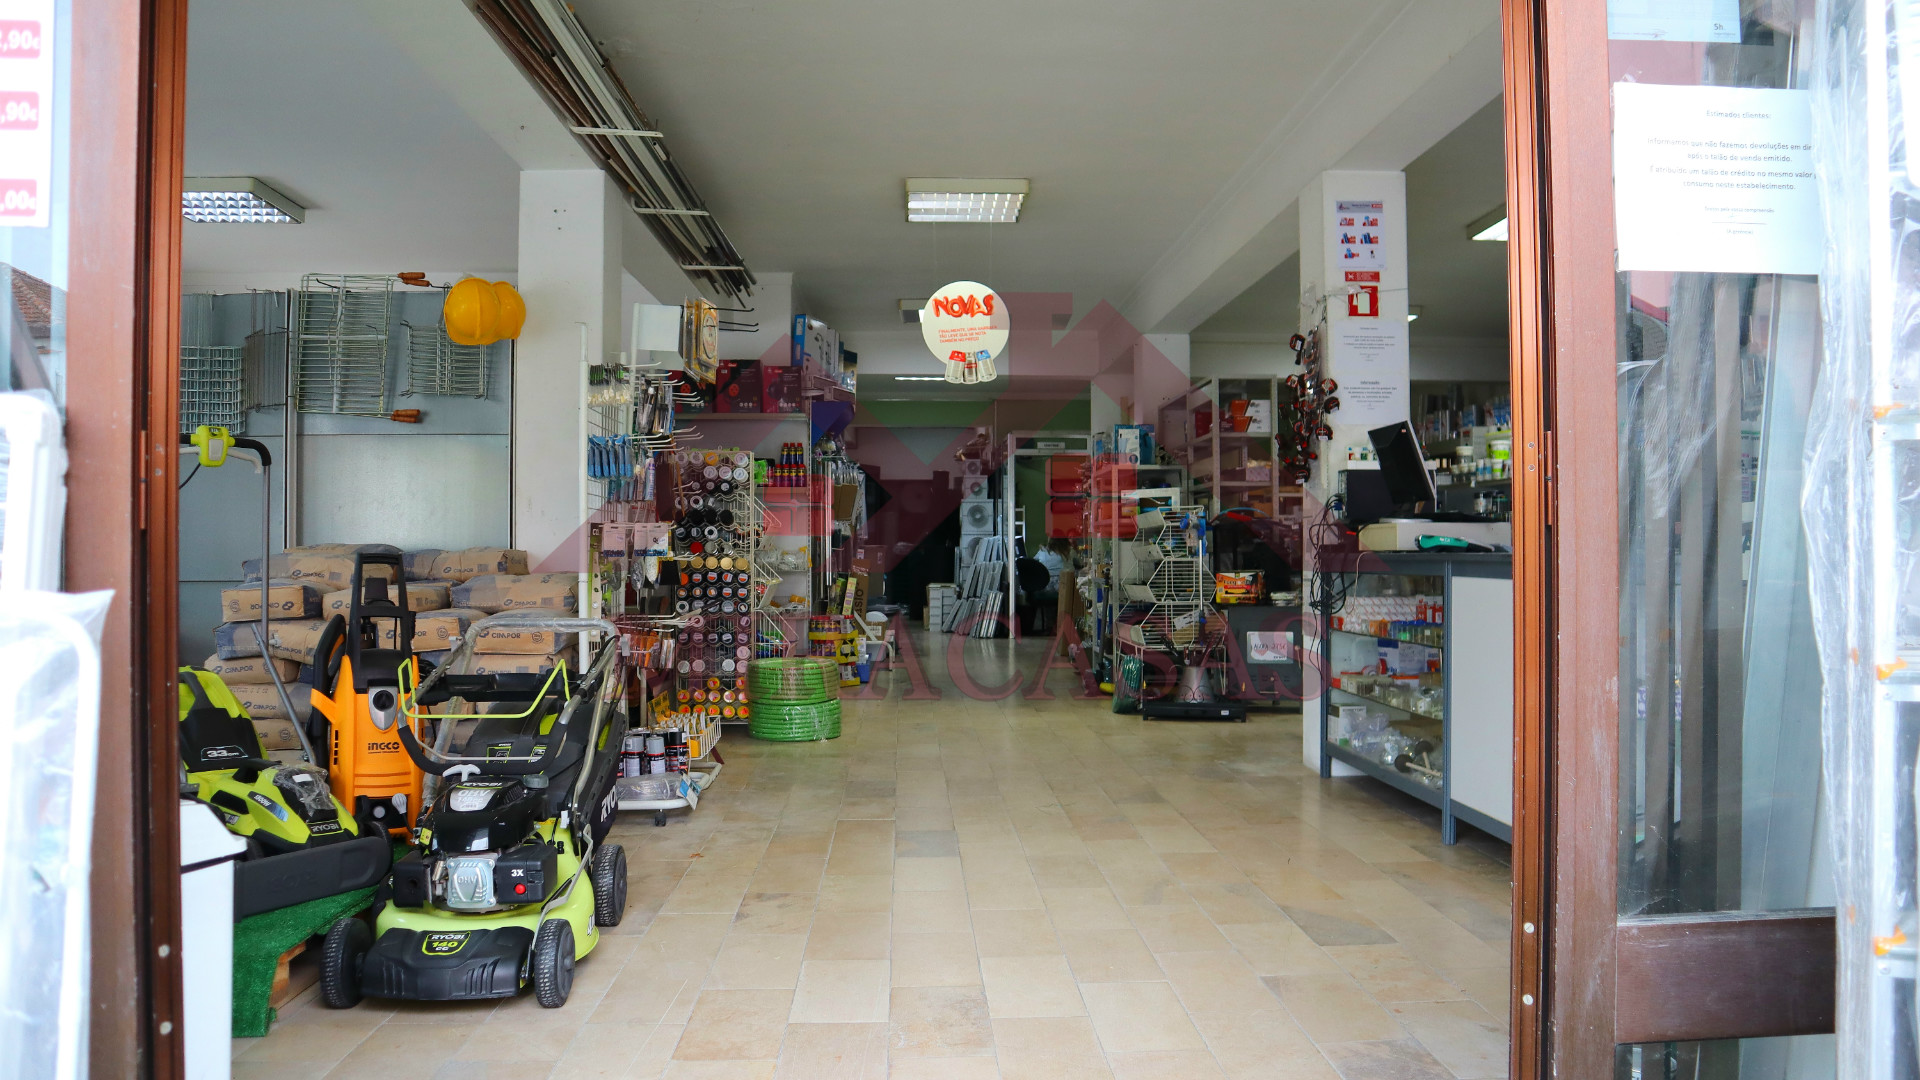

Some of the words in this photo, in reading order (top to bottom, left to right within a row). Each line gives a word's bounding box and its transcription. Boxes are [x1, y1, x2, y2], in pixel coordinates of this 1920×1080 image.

[0, 30, 40, 50] ,90€
[1706, 109, 1740, 118] Estimados
[1647, 137, 1689, 147] Informamos
[1691, 141, 1703, 149] que
[1705, 140, 1717, 149] não
[1719, 140, 1747, 149] fazemos
[1749, 142, 1789, 151] devoluções
[1687, 153, 1704, 162] após
[1710, 152, 1727, 161] talão
[1740, 154, 1762, 162] venda
[1763, 154, 1793, 163] emitido.
[1655, 166, 1688, 175] atribuído
[1701, 167, 1718, 176] talão
[1730, 169, 1755, 177] crédito
[1795, 170, 1813, 178] valor
[1736, 181, 1796, 191] estabelecimento.
[932, 294, 995, 318] NOVAS
[278, 645, 303, 655] CIMPOR
[224, 664, 254, 674] CIMPOR
[253, 703, 277, 711] CIMPOR
[206, 749, 240, 758] 33cm
[457, 789, 491, 797] OHV
[311, 823, 340, 833] RYOBI
[457, 875, 478, 884] OHV
[431, 940, 459, 948] 140
